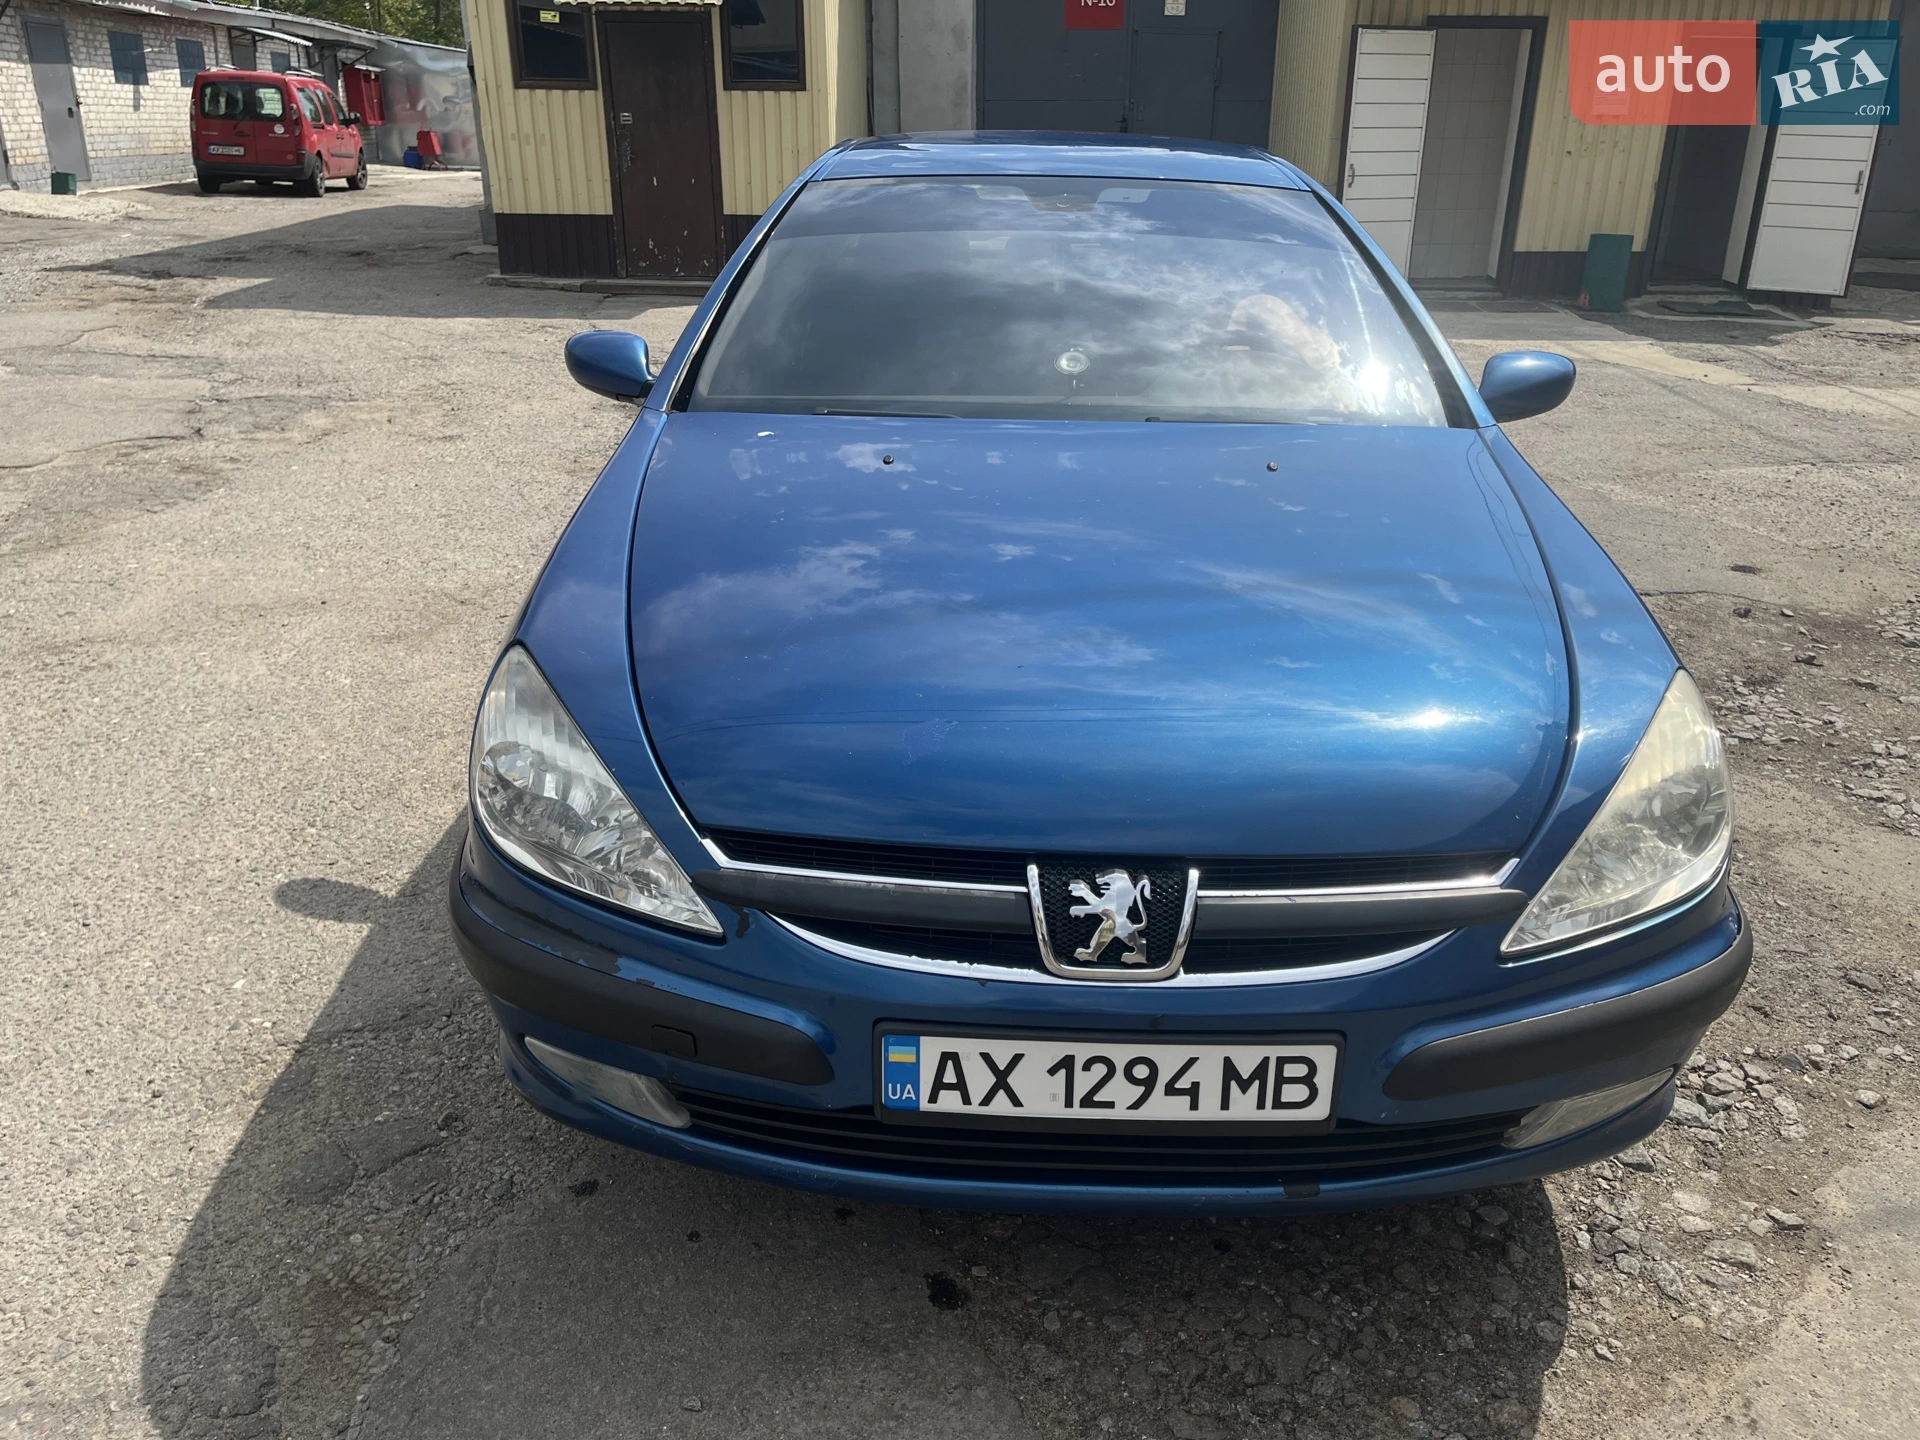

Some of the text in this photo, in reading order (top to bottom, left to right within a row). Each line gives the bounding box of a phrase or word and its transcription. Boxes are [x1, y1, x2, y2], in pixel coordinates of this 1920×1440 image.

[888, 1083, 916, 1101] UA
[927, 1051, 1320, 1111] AX 1294 MB
